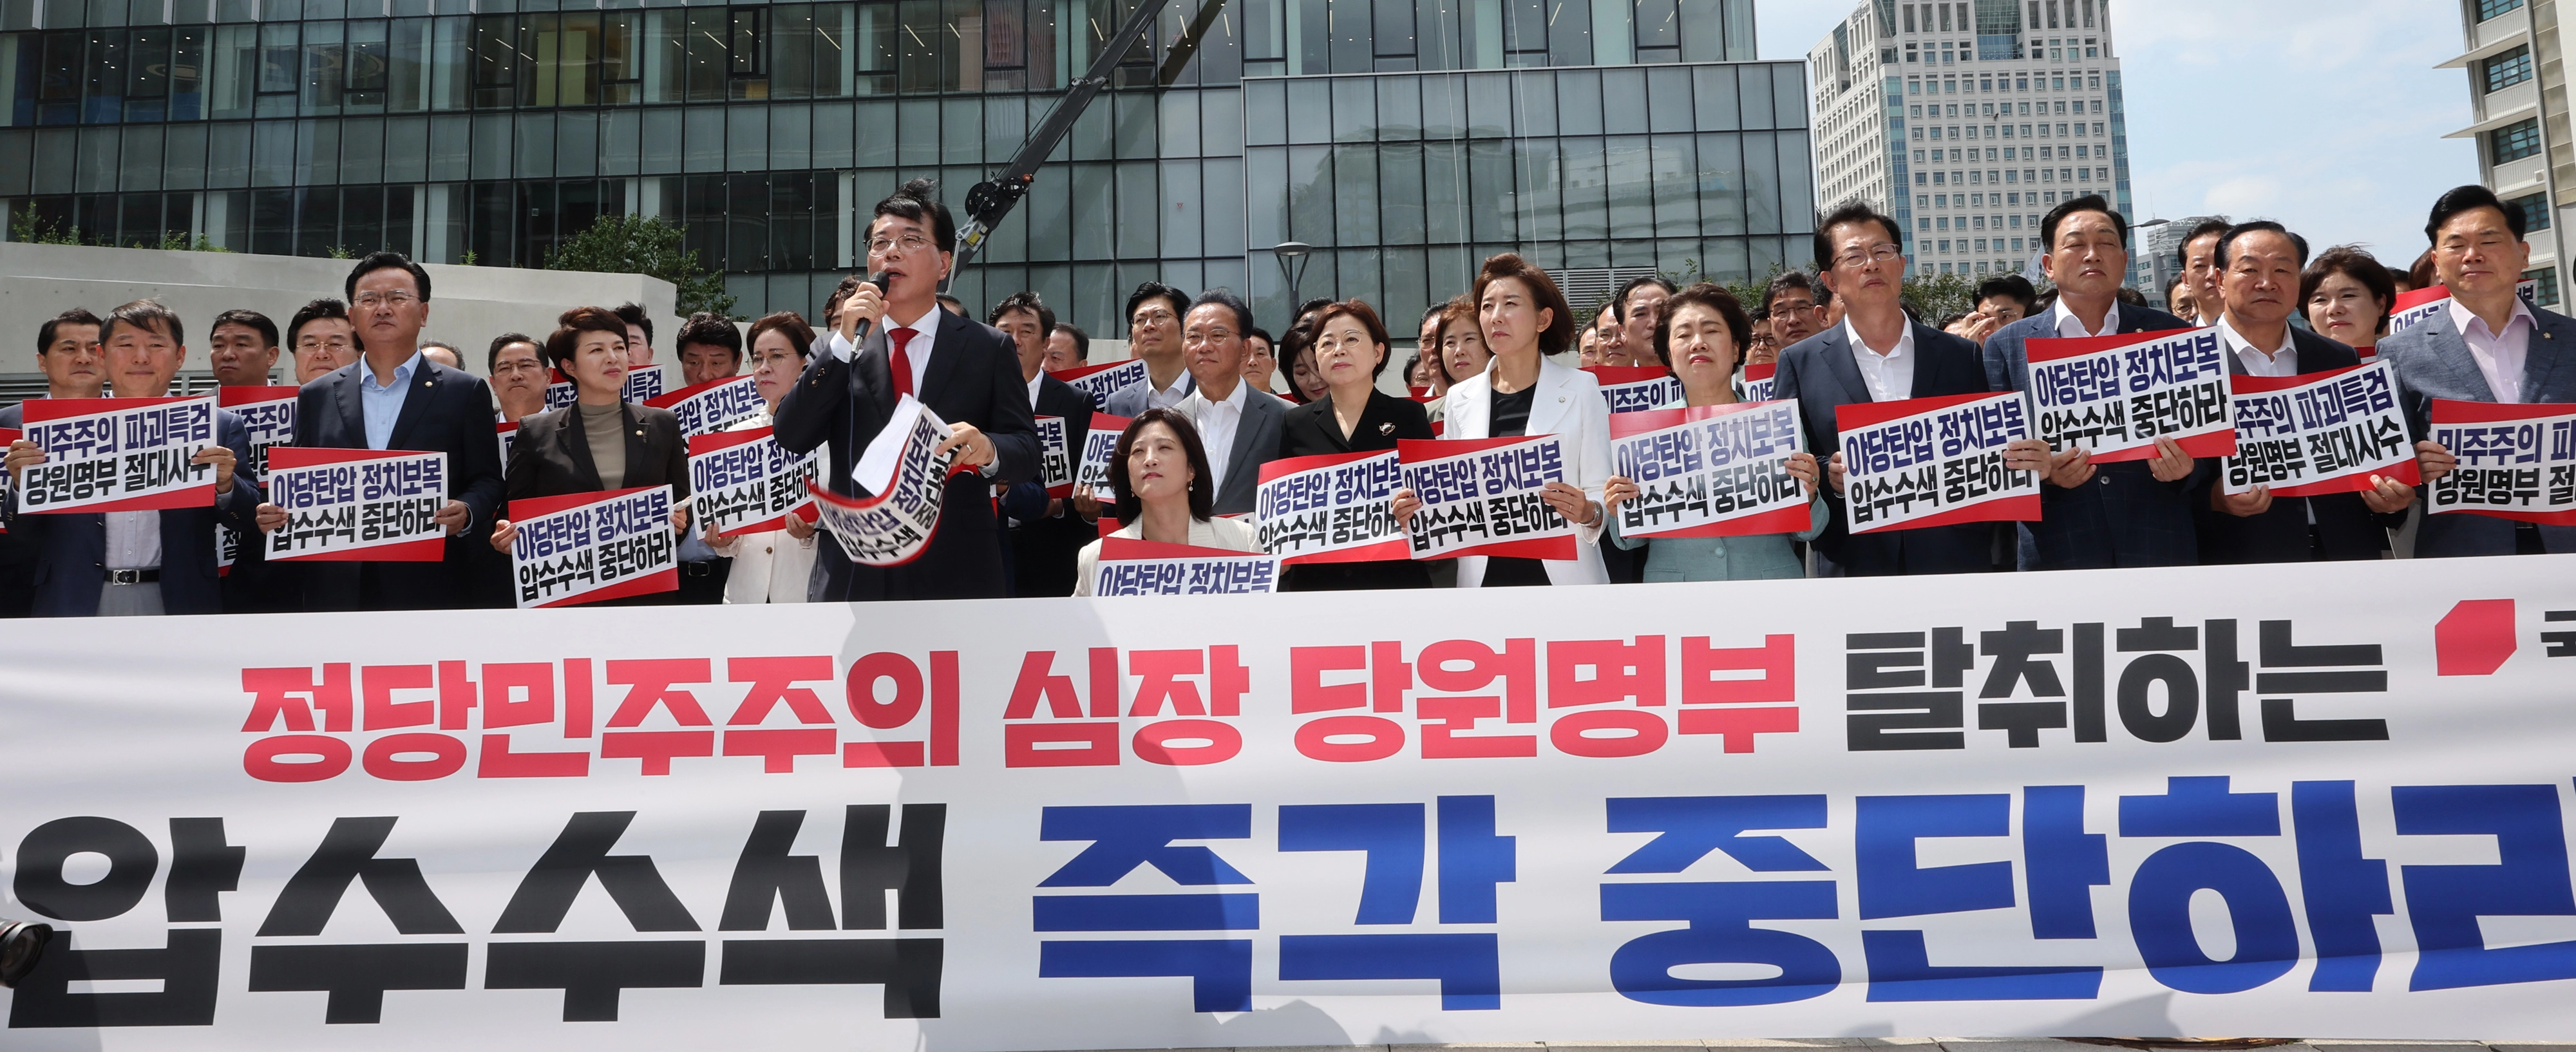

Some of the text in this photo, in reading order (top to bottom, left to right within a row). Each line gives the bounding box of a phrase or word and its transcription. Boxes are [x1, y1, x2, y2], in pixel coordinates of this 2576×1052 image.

[2036, 332, 2221, 407] 야당탄압 정치보복
[230, 402, 296, 440] 주주의
[671, 398, 701, 435] 탄압
[2041, 379, 2227, 452] 압수수색 중단하라
[2233, 367, 2394, 440] 주주의 파괴특검
[29, 402, 211, 464] 민주주의 파괴특검
[1034, 422, 1063, 452] 보복
[1086, 433, 1121, 463] 야당
[1618, 406, 1796, 483] 야당탄압 정치보복
[1846, 398, 2027, 477] 야당탄압 정치보복
[2228, 415, 2405, 487] 당원명부 절대사수
[2438, 423, 2543, 465] 민주주의
[26, 458, 117, 506] 당원명부
[124, 445, 211, 493] 절대사수
[274, 458, 442, 509] 야당탄압 정치보복
[694, 444, 763, 493] 야당탄압
[891, 414, 938, 514] 정치보복
[1040, 453, 1067, 484] 하라
[1081, 465, 1114, 493] 압수
[1405, 440, 1563, 505] 야당탄압 정치보복
[2436, 467, 2540, 506] 당원명부
[697, 481, 766, 532] 압수수색
[1260, 472, 1331, 521] 야당탄압
[1622, 474, 1709, 528] 압수수색
[1851, 465, 1938, 524] 압수수색
[273, 505, 356, 552] 압수수색
[361, 496, 442, 541] 중단하라
[516, 491, 668, 561] 야당탄압 정치보복
[1259, 511, 1327, 554] 압수수색
[1410, 500, 1488, 552] 압수수색
[520, 529, 672, 603] 압수수색 중단하라
[1098, 560, 1274, 596] 야당탄압 정치보복
[241, 616, 2389, 783] 정당민주주의 심장 당원명부 탈취하는
[8, 803, 947, 1028] 압수수색
[1032, 794, 1517, 1013] 즉각
